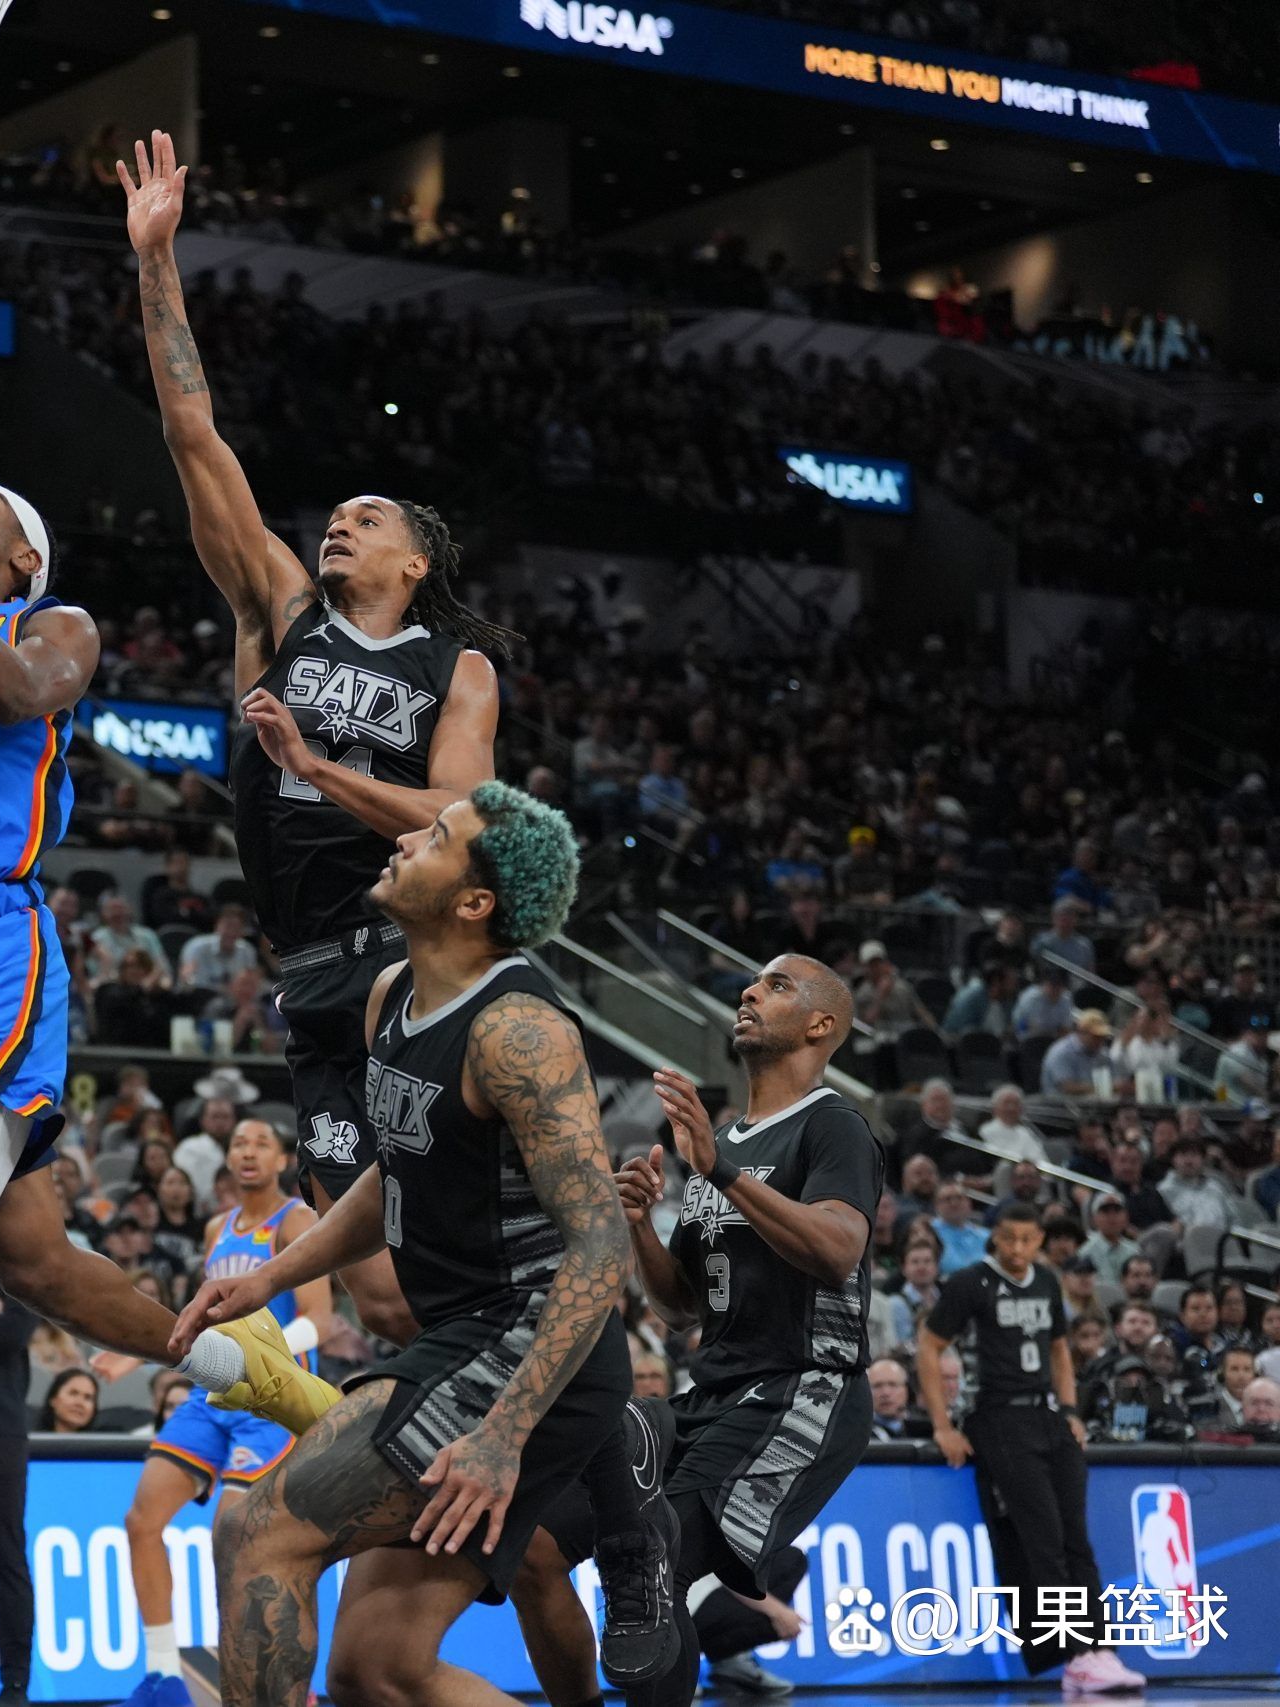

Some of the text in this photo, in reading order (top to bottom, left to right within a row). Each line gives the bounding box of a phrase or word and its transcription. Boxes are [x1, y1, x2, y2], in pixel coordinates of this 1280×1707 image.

[567, 1, 664, 56] USAA
[805, 43, 1150, 129] MORE THAN YOU MIGHT THINK
[824, 462, 901, 505] USAA
[284, 656, 436, 752] SATX
[130, 718, 213, 761] USAA
[365, 1056, 444, 1155] SATX
[706, 1253, 730, 1311] 3
[1020, 1341, 1041, 1372] 0
